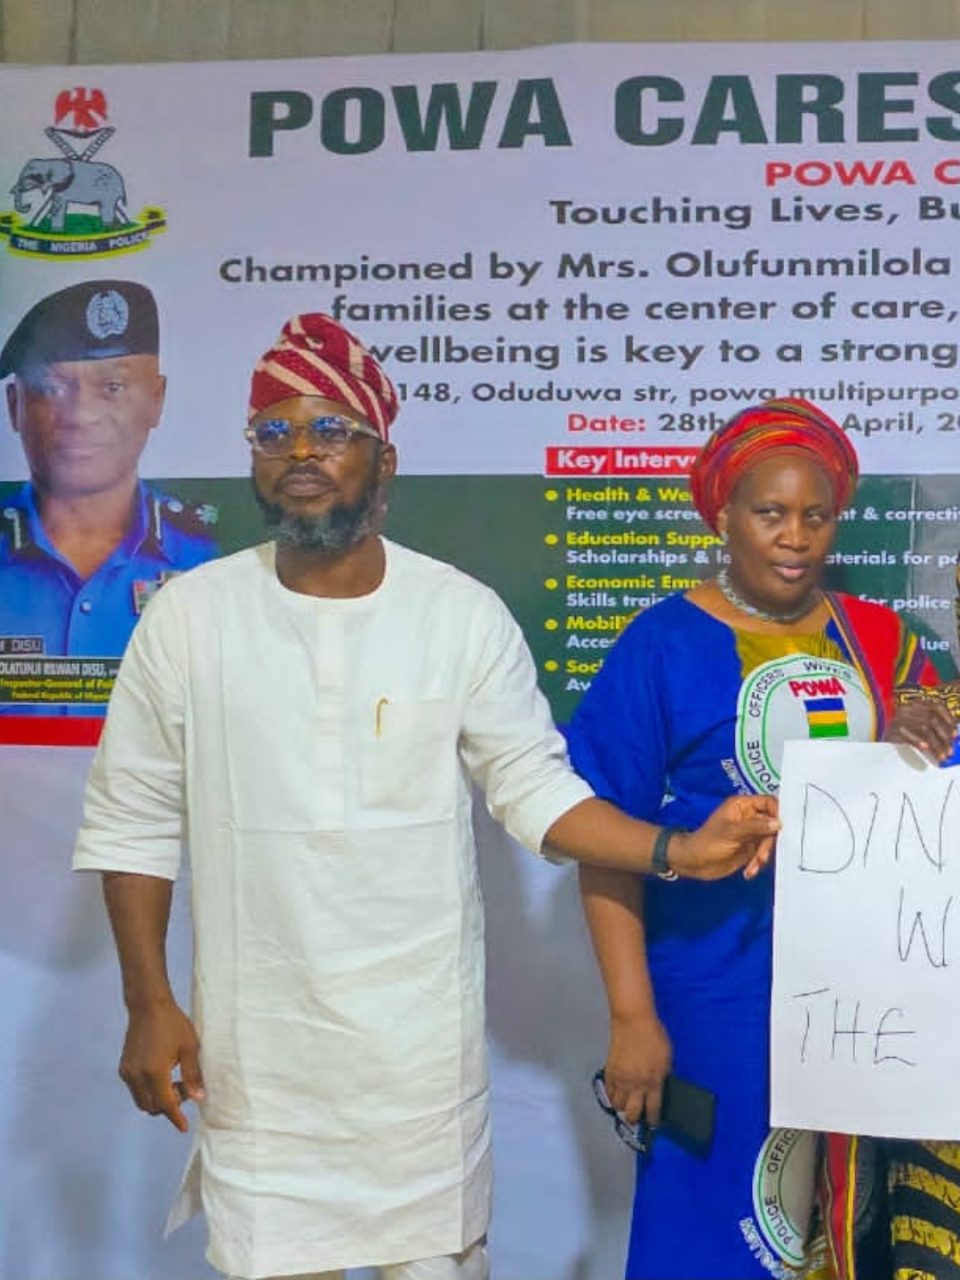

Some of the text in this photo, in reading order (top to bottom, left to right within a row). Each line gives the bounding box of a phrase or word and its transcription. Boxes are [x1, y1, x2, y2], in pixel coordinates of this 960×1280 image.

[248, 78, 573, 158] POWA
[765, 160, 917, 187] POWA
[549, 197, 752, 229] Touching
[771, 196, 899, 226] Lives,
[18, 231, 148, 253] THE NIGERIA POLICE
[219, 252, 474, 287] Championed
[489, 254, 542, 287] by
[557, 253, 649, 279] Mrs.
[666, 248, 951, 279] Olufunmilola
[332, 295, 492, 322] families
[507, 298, 549, 321] at
[563, 294, 629, 321] the
[645, 296, 778, 321] center
[792, 292, 837, 320] of
[851, 297, 958, 324] care,
[577, 336, 609, 363] is
[625, 335, 708, 370] key
[719, 340, 761, 363] to
[776, 344, 803, 363] a
[819, 339, 959, 369] strong
[397, 382, 461, 404] 148,
[471, 380, 622, 402] Oduduwa
[634, 383, 677, 404] str,
[690, 386, 777, 406] powa
[567, 413, 647, 433] Date:
[842, 410, 925, 437] April,
[557, 449, 698, 473] Key Interv
[566, 487, 695, 502] Health & We
[566, 506, 608, 520] Free
[613, 509, 649, 523] eye
[862, 506, 880, 521] &
[566, 531, 660, 546] Education
[566, 549, 688, 567] Scholarships
[693, 550, 710, 565] &
[824, 551, 896, 566] aterials
[903, 551, 929, 565] for
[566, 574, 655, 590] Economic
[566, 592, 617, 608] Skills
[893, 594, 951, 612] police
[566, 615, 626, 630] Mobil
[11, 639, 42, 652] DISU
[919, 636, 950, 651] lue
[788, 676, 847, 698] POWA
[747, 740, 780, 792] POLICE
[793, 987, 917, 1067] THE
[766, 1128, 800, 1174] OFFIC
[765, 1194, 794, 1246] POLICE
